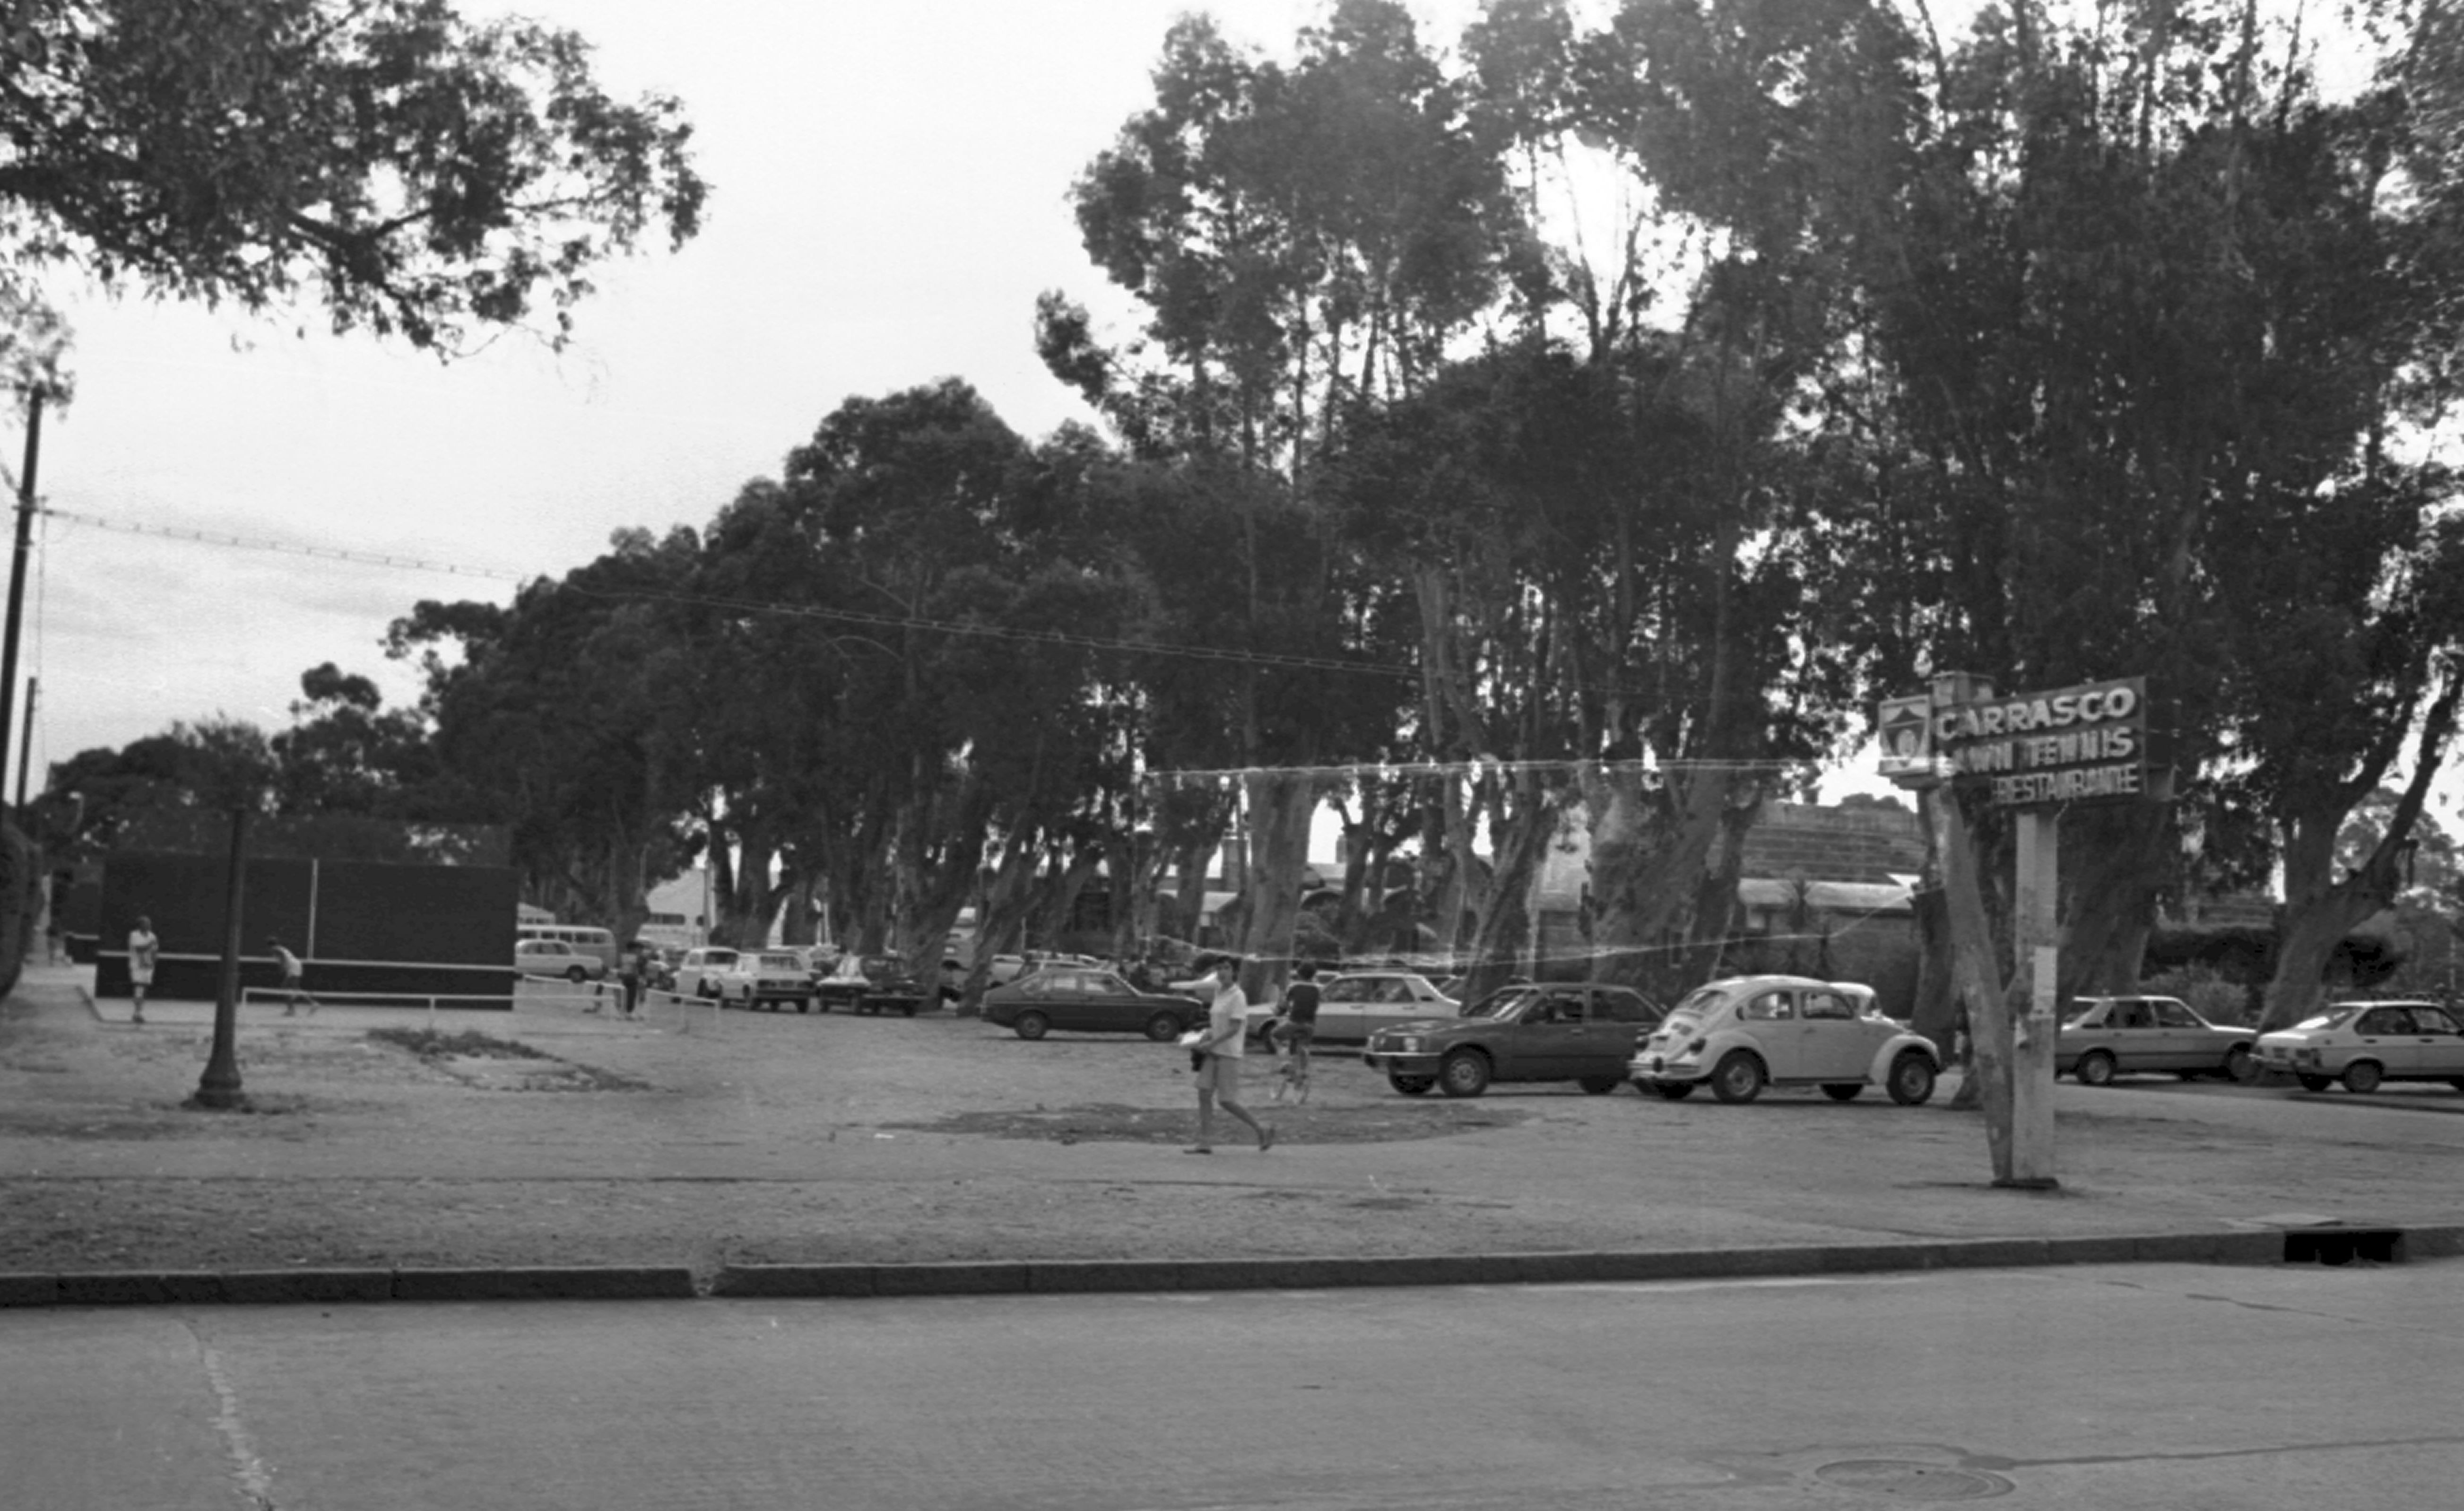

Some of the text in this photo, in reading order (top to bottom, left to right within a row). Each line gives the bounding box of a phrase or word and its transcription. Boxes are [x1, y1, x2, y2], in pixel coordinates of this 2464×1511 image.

[1936, 687, 2135, 740] CARRASCO
[2028, 727, 2134, 767] TENNIS
[1992, 763, 2139, 803] RESTAURANTE
